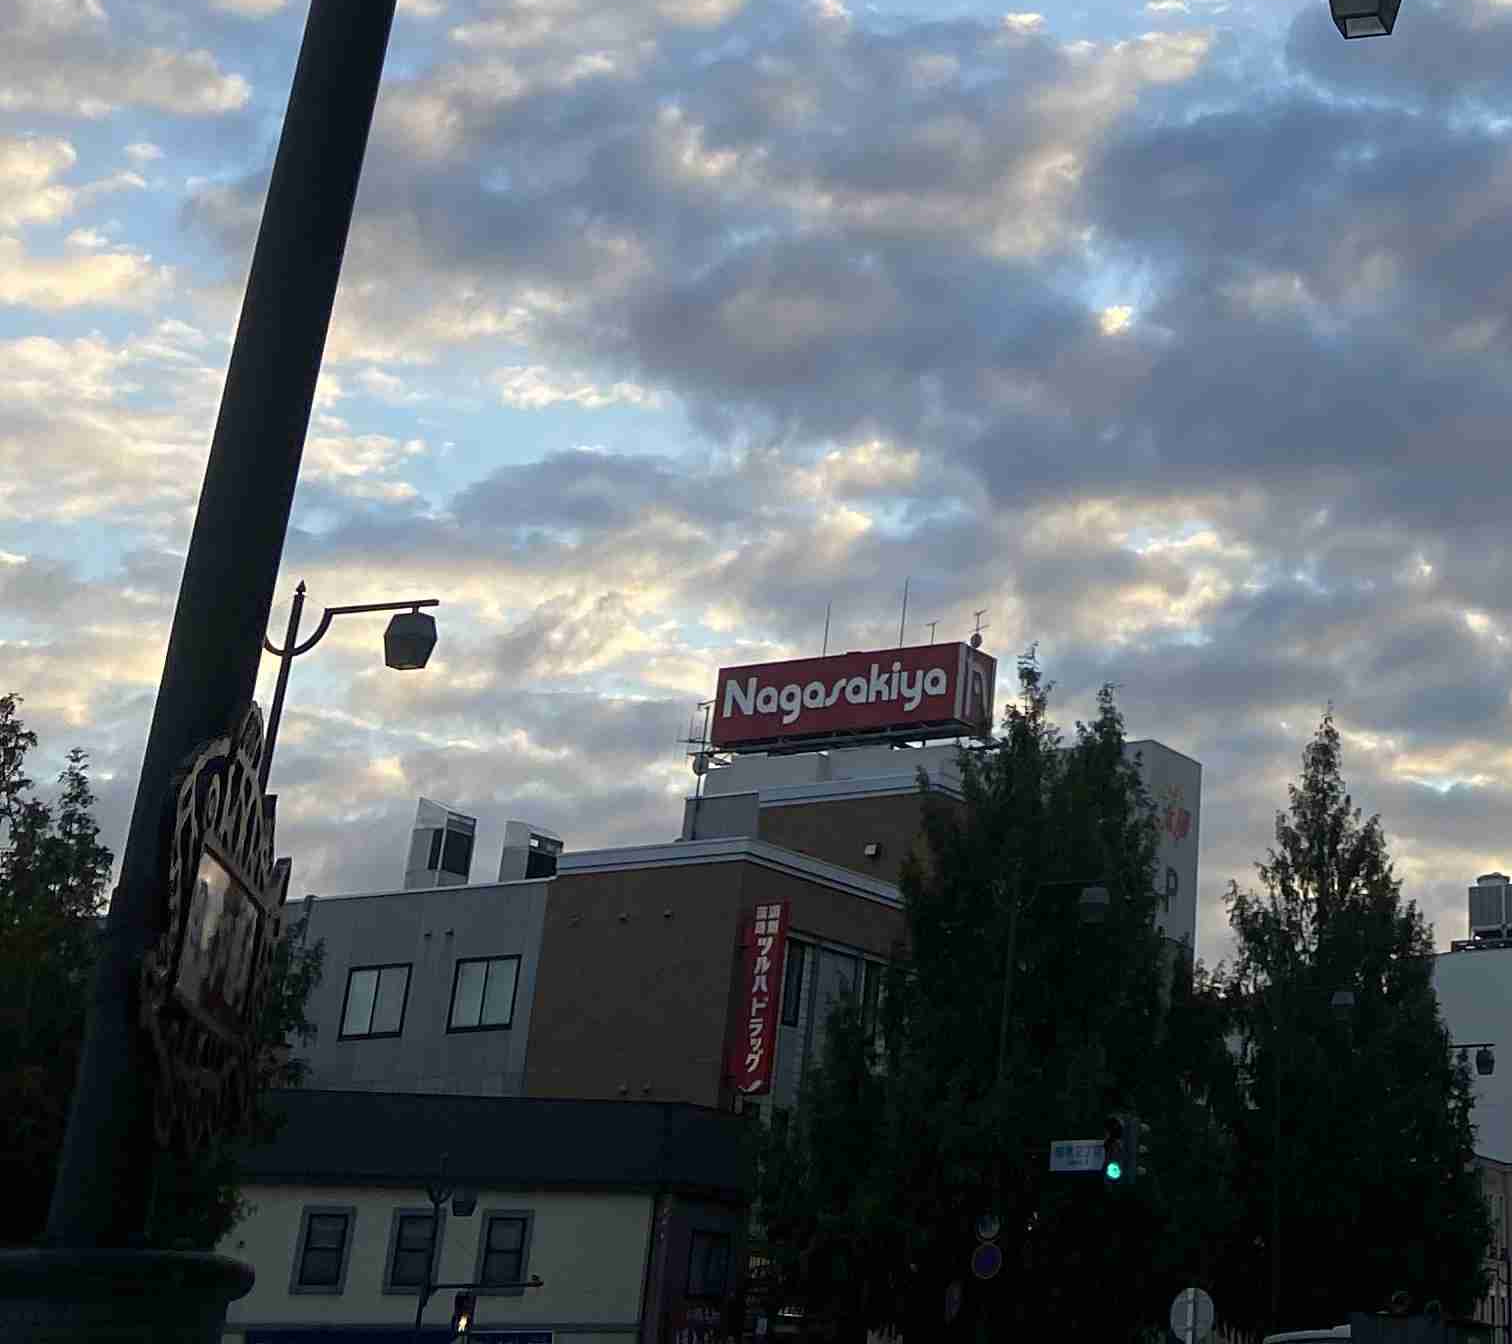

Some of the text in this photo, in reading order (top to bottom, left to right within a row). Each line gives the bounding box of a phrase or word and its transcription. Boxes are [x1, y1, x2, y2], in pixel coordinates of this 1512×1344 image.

[722, 661, 947, 724] Nagasakiya
[745, 935, 776, 1073] ツルハドラッグ
